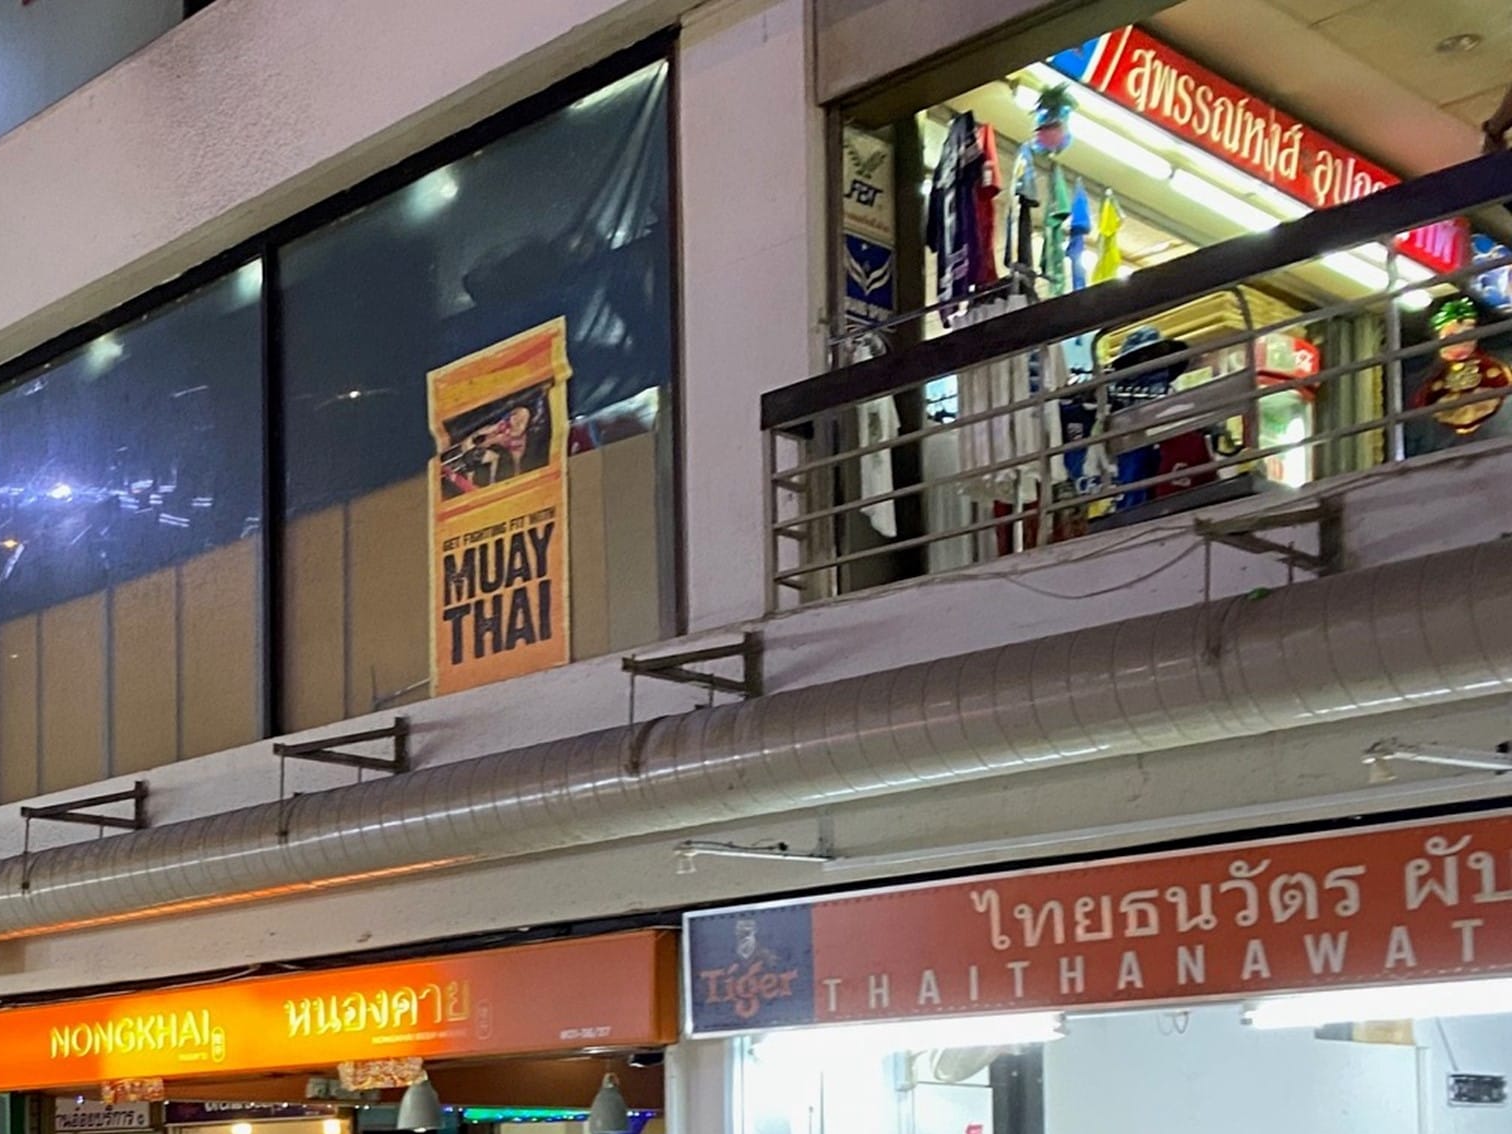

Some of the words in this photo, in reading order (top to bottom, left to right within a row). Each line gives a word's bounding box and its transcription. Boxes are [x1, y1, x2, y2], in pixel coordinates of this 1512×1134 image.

[443, 521, 556, 607] MUAY
[442, 579, 553, 666] THAI
[970, 857, 1367, 951] ไทยธนวัตร
[699, 960, 799, 1019] Tiger
[49, 1008, 210, 1060] NONGKHAI
